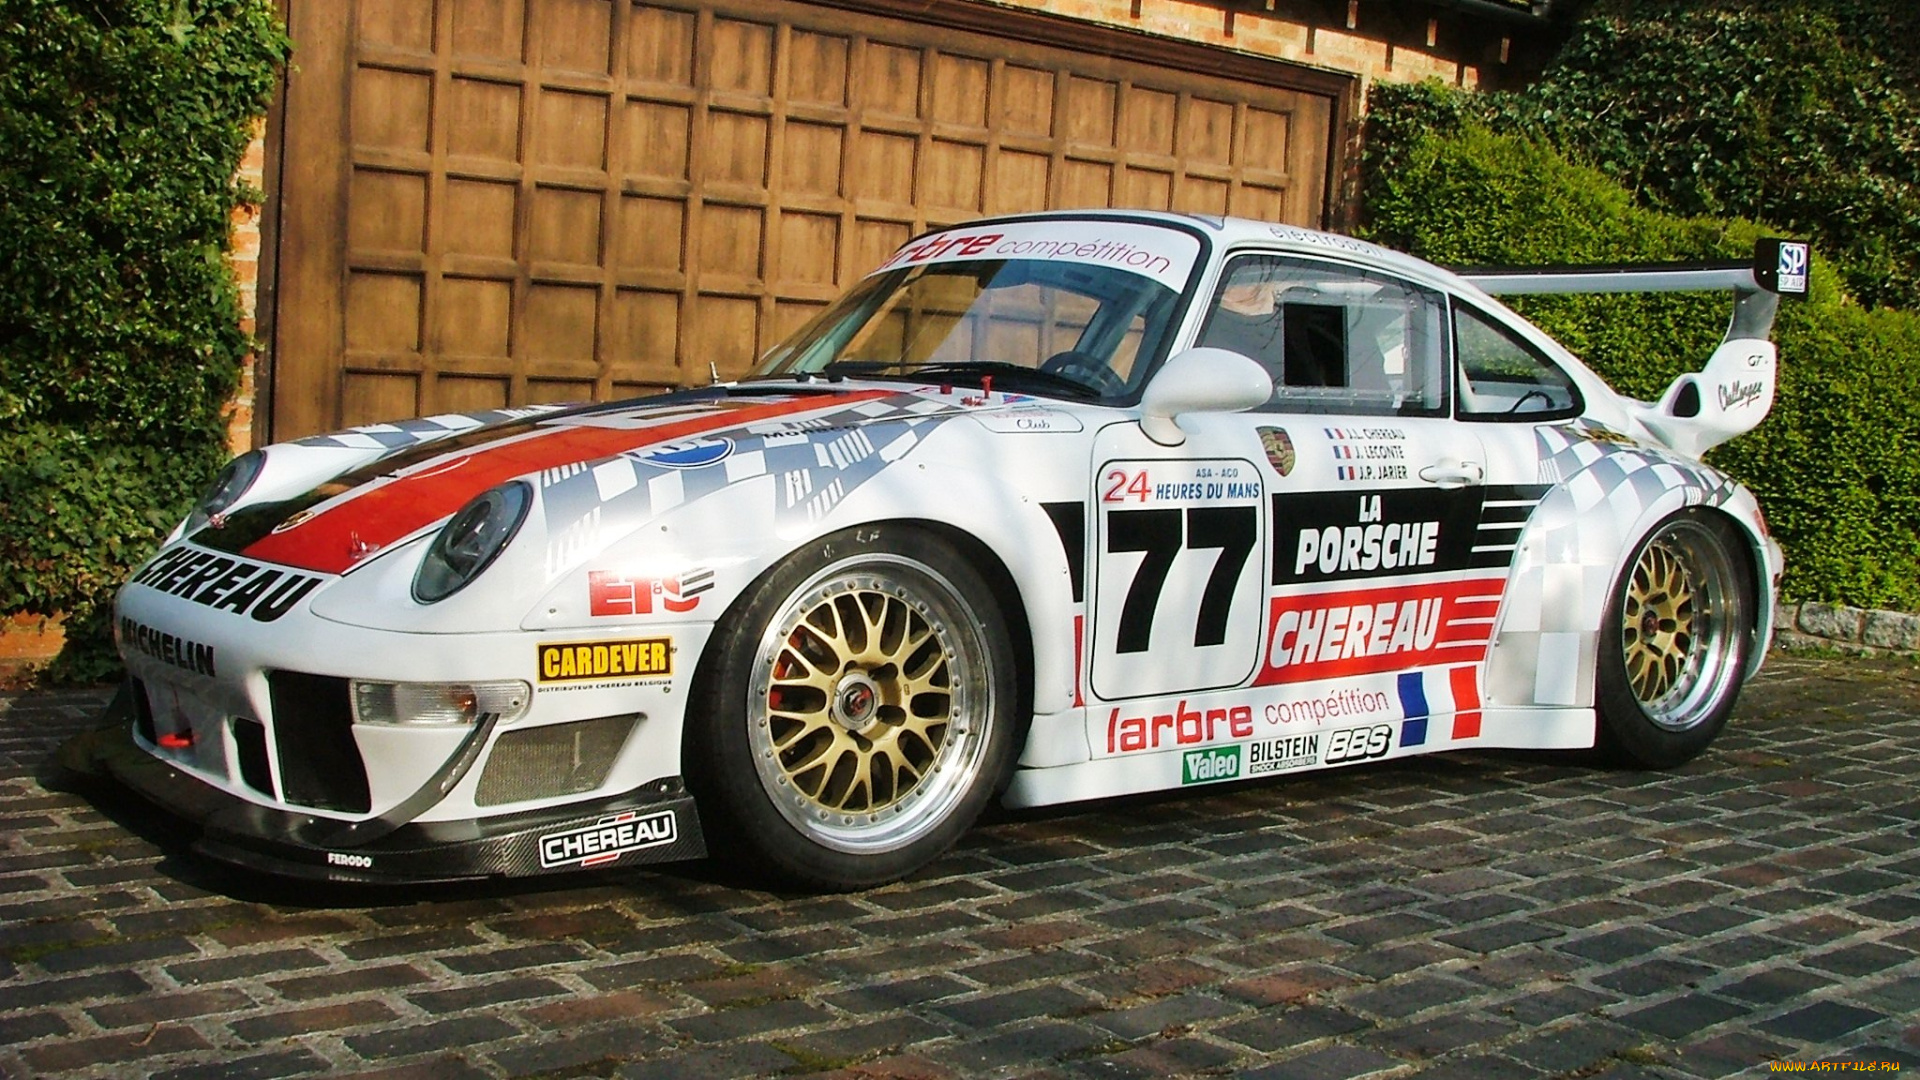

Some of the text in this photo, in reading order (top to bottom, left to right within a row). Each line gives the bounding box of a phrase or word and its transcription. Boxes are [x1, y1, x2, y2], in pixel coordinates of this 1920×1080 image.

[996, 238, 1170, 274] compétition
[1780, 245, 1804, 274] SP
[1363, 429, 1405, 440] CHEREAU
[1364, 446, 1404, 459] LECONTE
[1102, 469, 1260, 504] 24 HEURES DU MANS
[1196, 468, 1212, 478] ASA
[1221, 468, 1239, 478] ACO
[1360, 466, 1408, 480] J.P. JARIER
[1359, 495, 1382, 522] LA
[1295, 521, 1440, 575] PORSCHE
[132, 546, 324, 623] CHEREAU
[1107, 506, 1257, 654] 77
[122, 615, 215, 677] MICHELIN
[1269, 597, 1443, 669] CHEREAU
[544, 642, 666, 678] CARDEVER
[538, 684, 593, 693] DISTRIBUTEUR
[596, 682, 632, 690] CHEREAU
[1107, 689, 1390, 754] larbre compétition
[1250, 735, 1319, 763] BILSTEIN
[1325, 725, 1393, 765] BBS
[1186, 752, 1237, 781] Valeo
[545, 817, 672, 861] CHEREAU
[328, 853, 372, 868] FERODO
